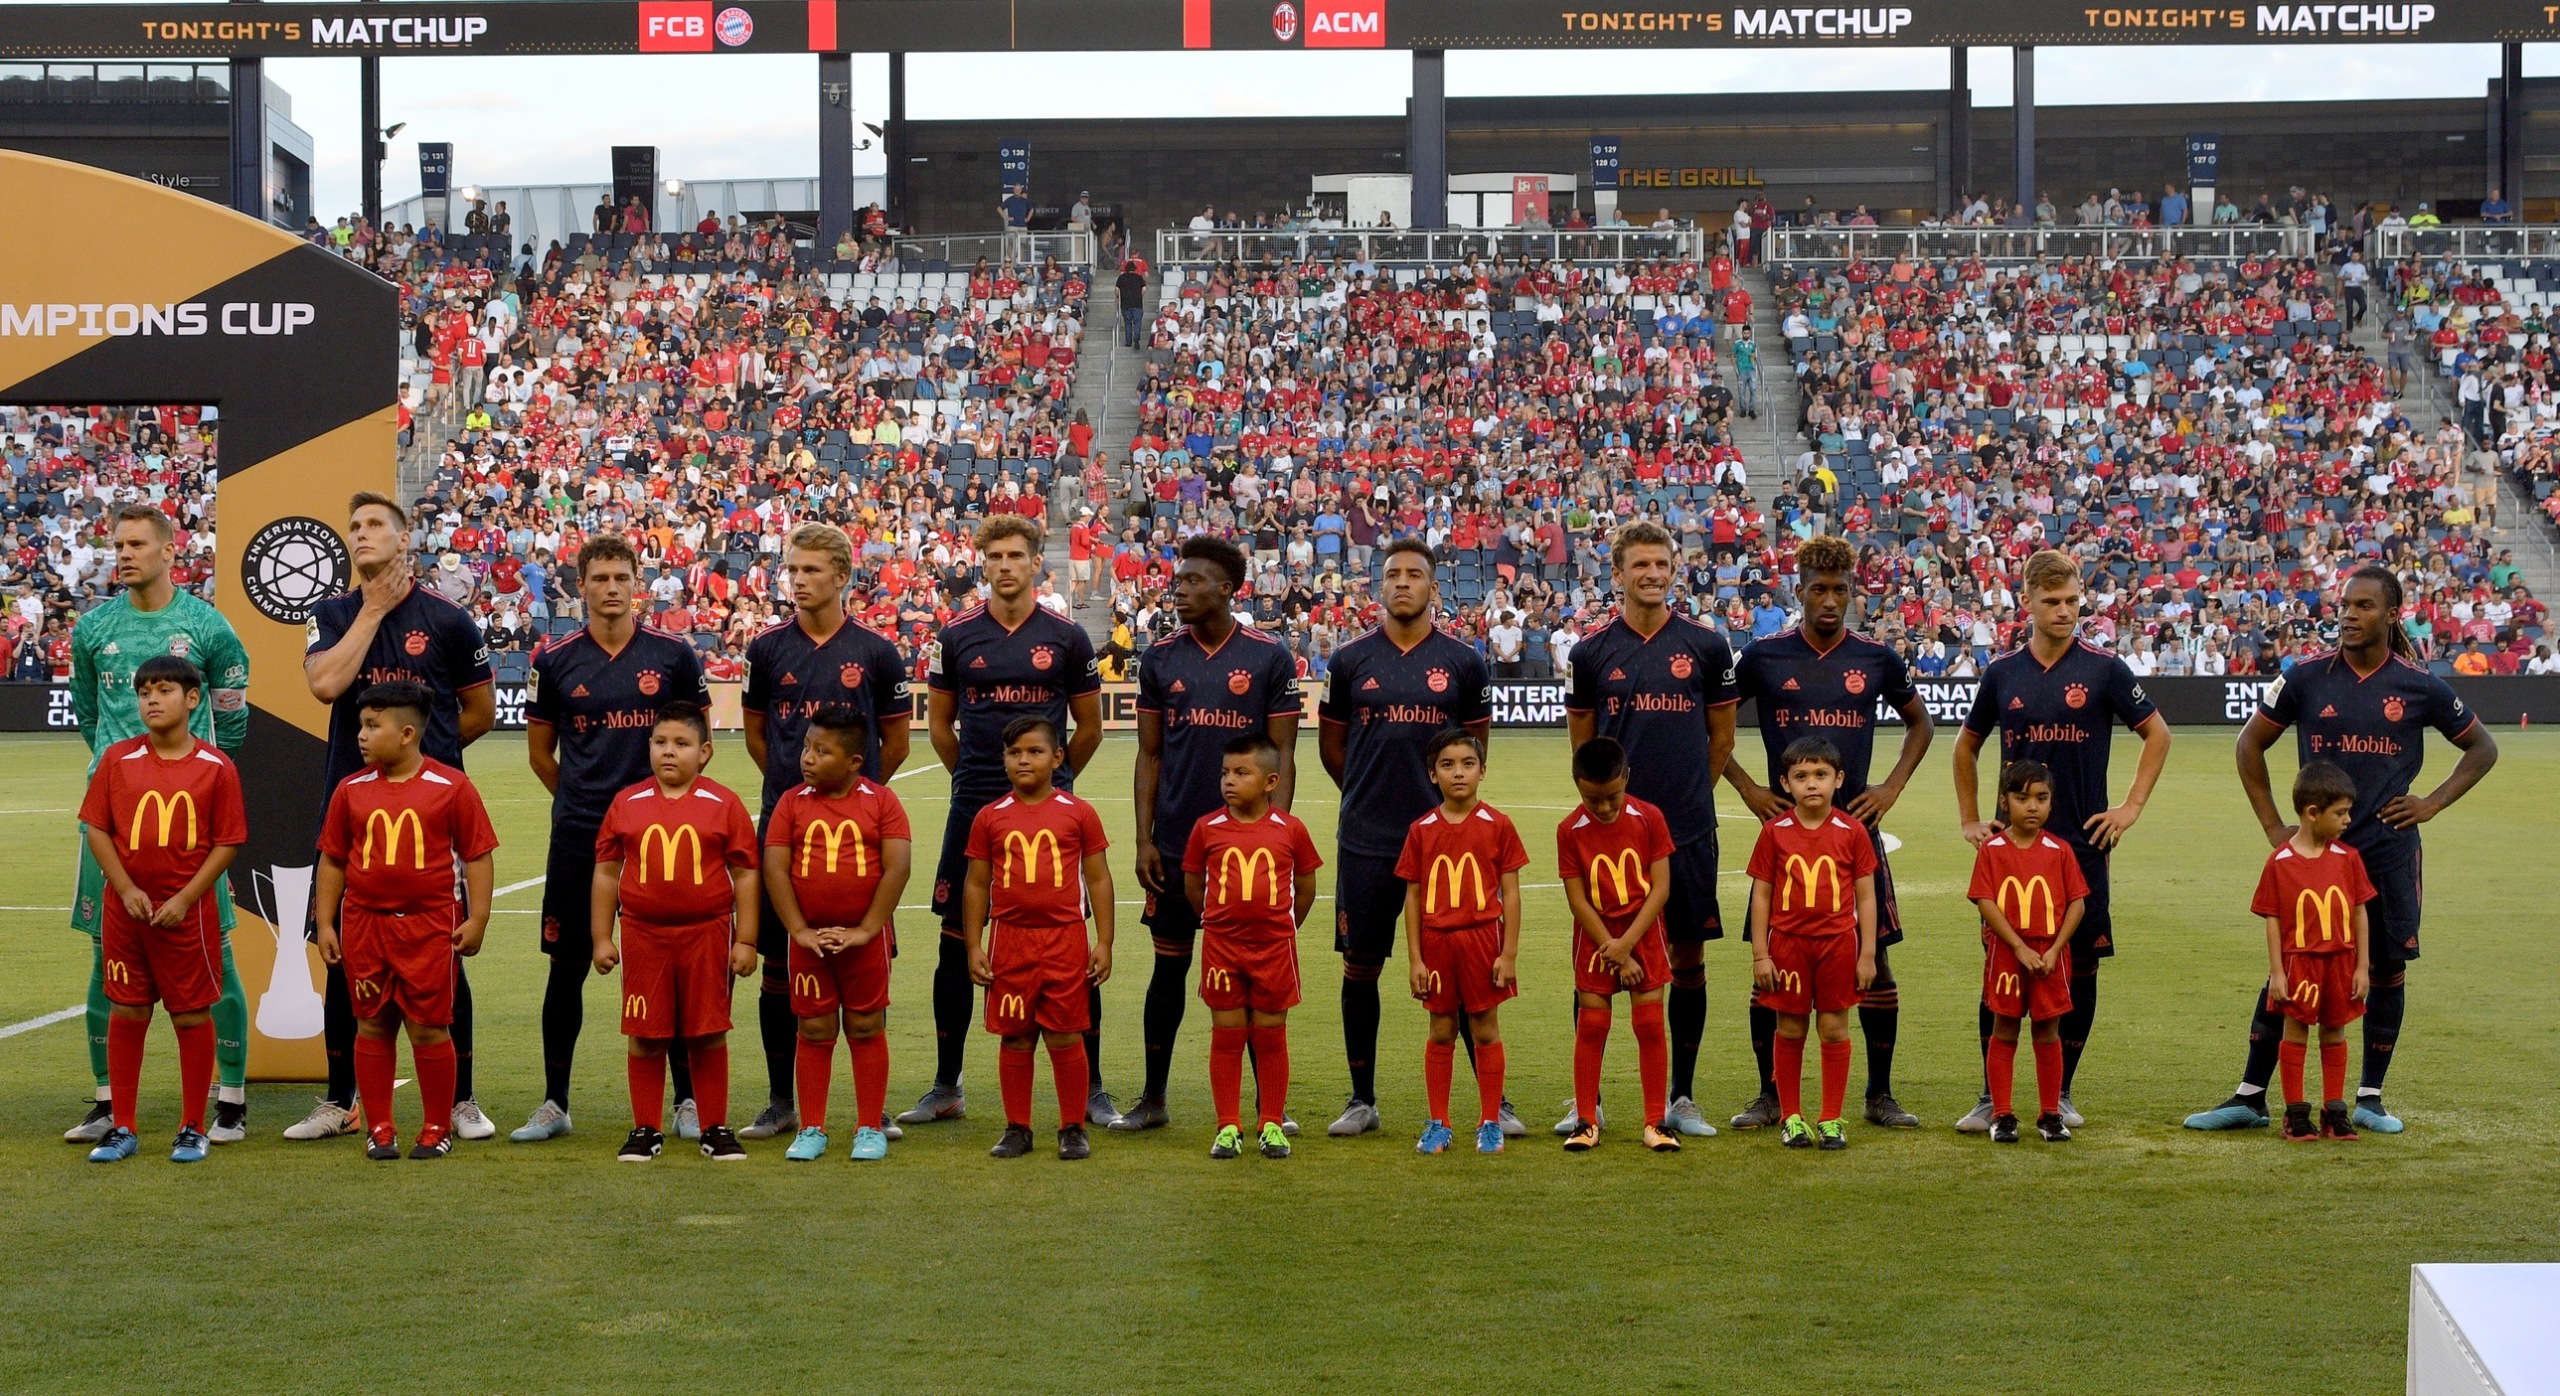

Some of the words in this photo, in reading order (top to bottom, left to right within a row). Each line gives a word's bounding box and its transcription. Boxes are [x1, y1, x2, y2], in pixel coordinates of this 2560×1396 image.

[649, 16, 704, 37] FCB
[1312, 12, 1378, 33] ACM
[1562, 12, 1723, 32] TONIGHT'S
[1734, 8, 1912, 35] MATCHUP
[2085, 9, 2246, 29] TONIGHT'S
[2257, 4, 2436, 32] MATCHUP
[142, 22, 300, 40] TONIGHT'S
[312, 17, 487, 43] MATCHUP
[1003, 162, 1016, 170] 129
[1595, 159, 1608, 167] 128
[2193, 156, 2207, 164] 127
[151, 173, 190, 188] Style
[1618, 168, 1672, 187] THE
[1680, 167, 1764, 187] GRILL
[1, 302, 208, 337] MPIONS
[221, 302, 315, 336] CUP
[247, 521, 346, 565] INTERNATIONAL
[246, 576, 311, 621] CHAMPION
[995, 685, 1049, 704] Mobile
[1635, 693, 1692, 713] Mobile
[1190, 708, 1247, 729] Mobile
[1388, 705, 1444, 725] Mobile
[1809, 709, 1863, 729] Mobile
[2028, 723, 2085, 743] Mobile
[2341, 734, 2397, 756] Mobile
[217, 1038, 240, 1048] FCB
